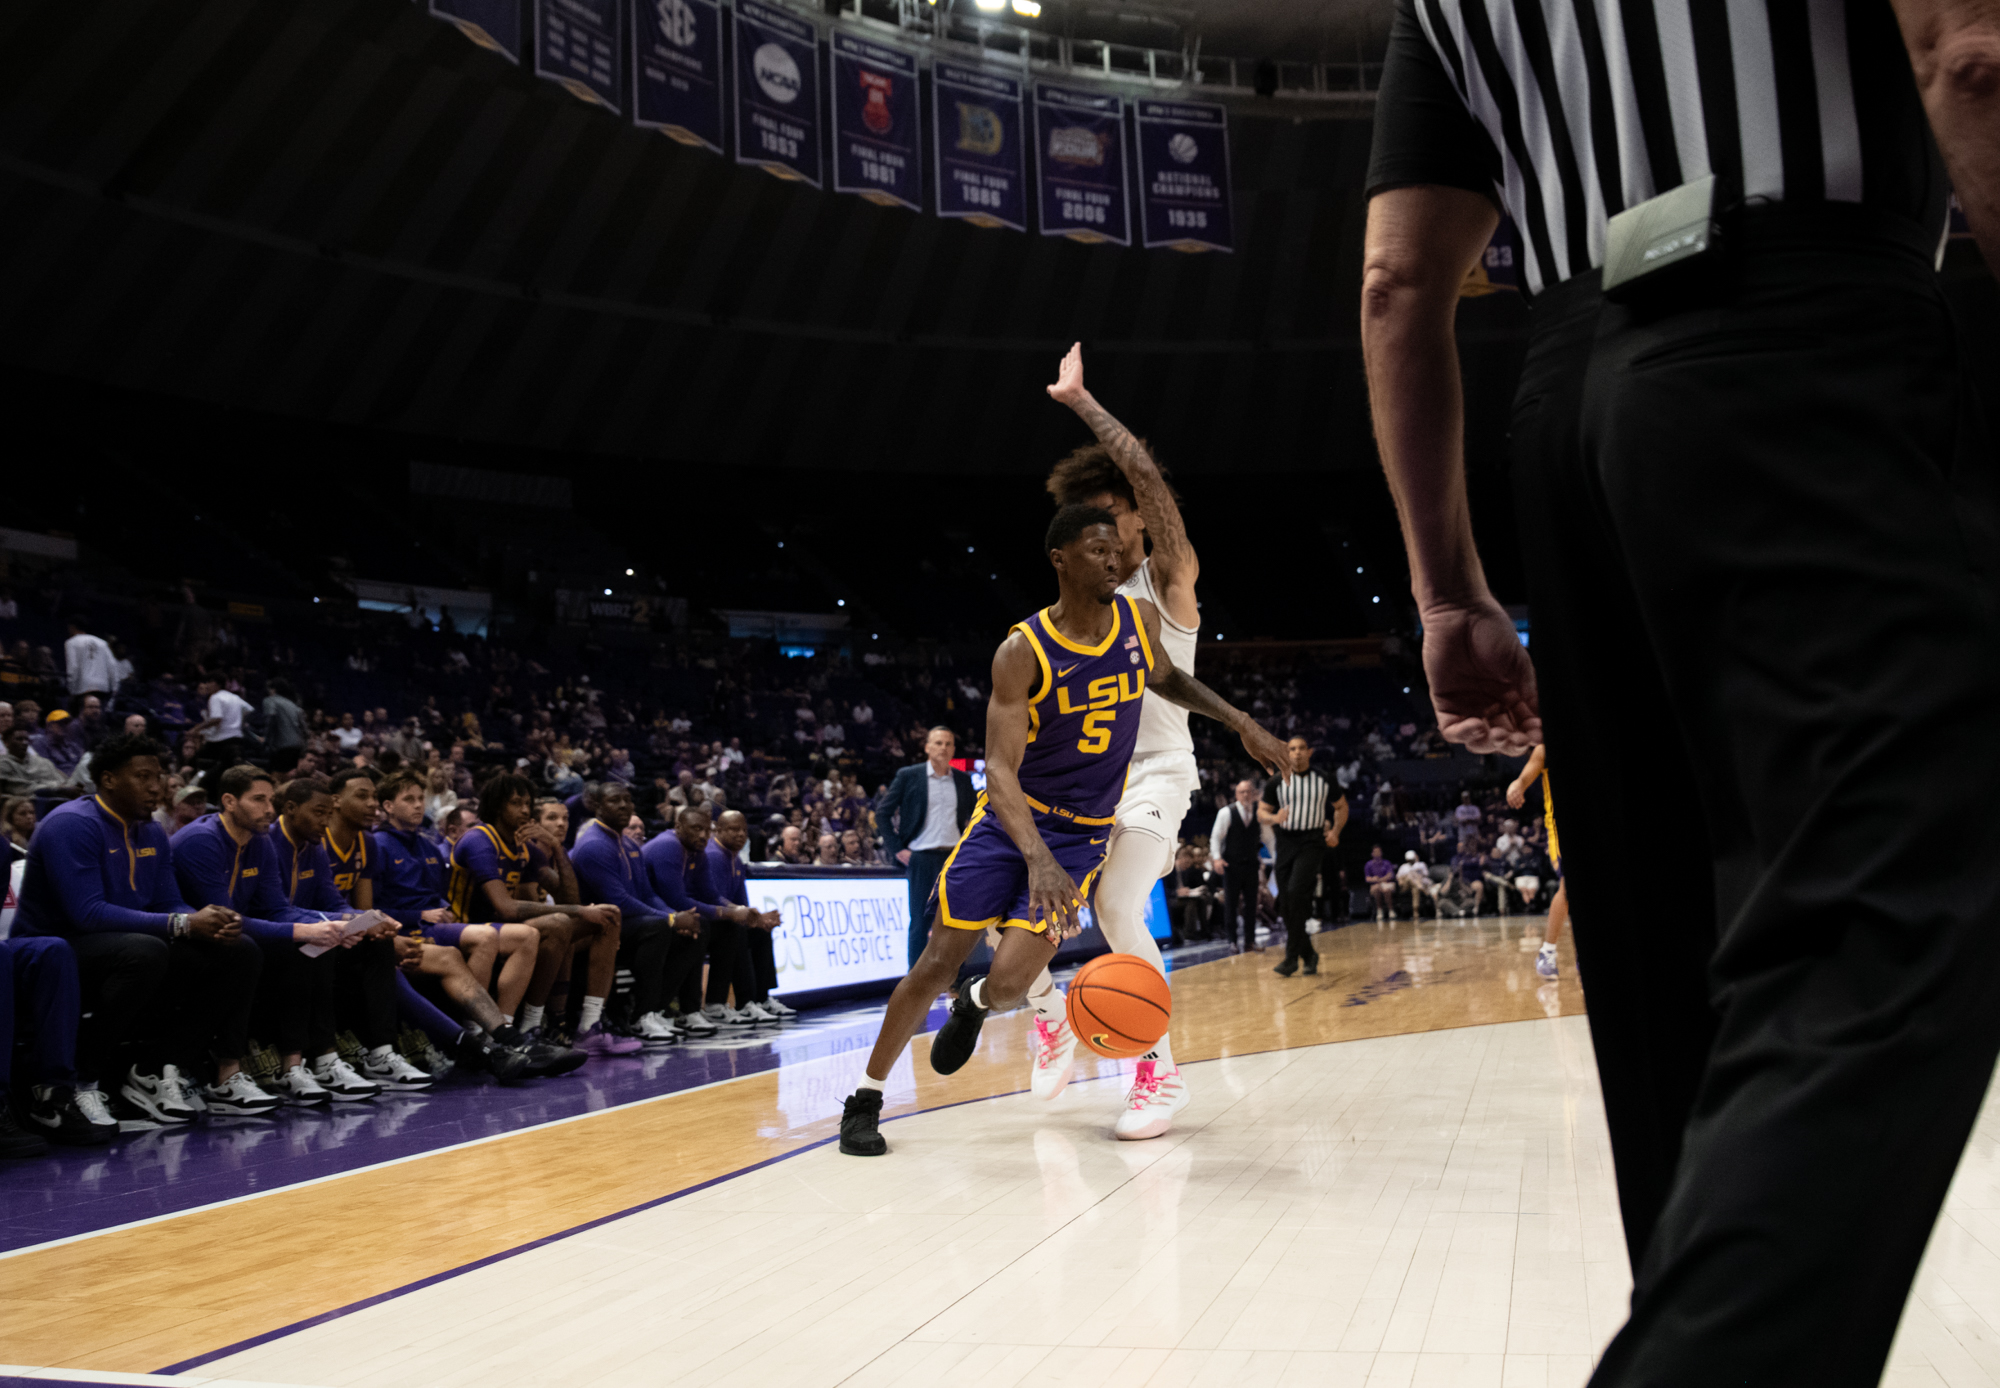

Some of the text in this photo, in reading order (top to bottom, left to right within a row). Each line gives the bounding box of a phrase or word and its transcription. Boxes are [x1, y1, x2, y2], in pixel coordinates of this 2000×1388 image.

[656, 0, 697, 47] SEC
[1151, 181, 1221, 199] CHAMPIONS
[1157, 170, 1213, 187] NATIONAL
[1056, 668, 1145, 715] LSU
[1077, 710, 1117, 754] 5
[1052, 805, 1075, 819] LSU
[136, 847, 157, 858] LSU
[334, 872, 362, 891] SU
[797, 894, 905, 938] BRIDGEWAY
[826, 935, 893, 967] HOSPICE
